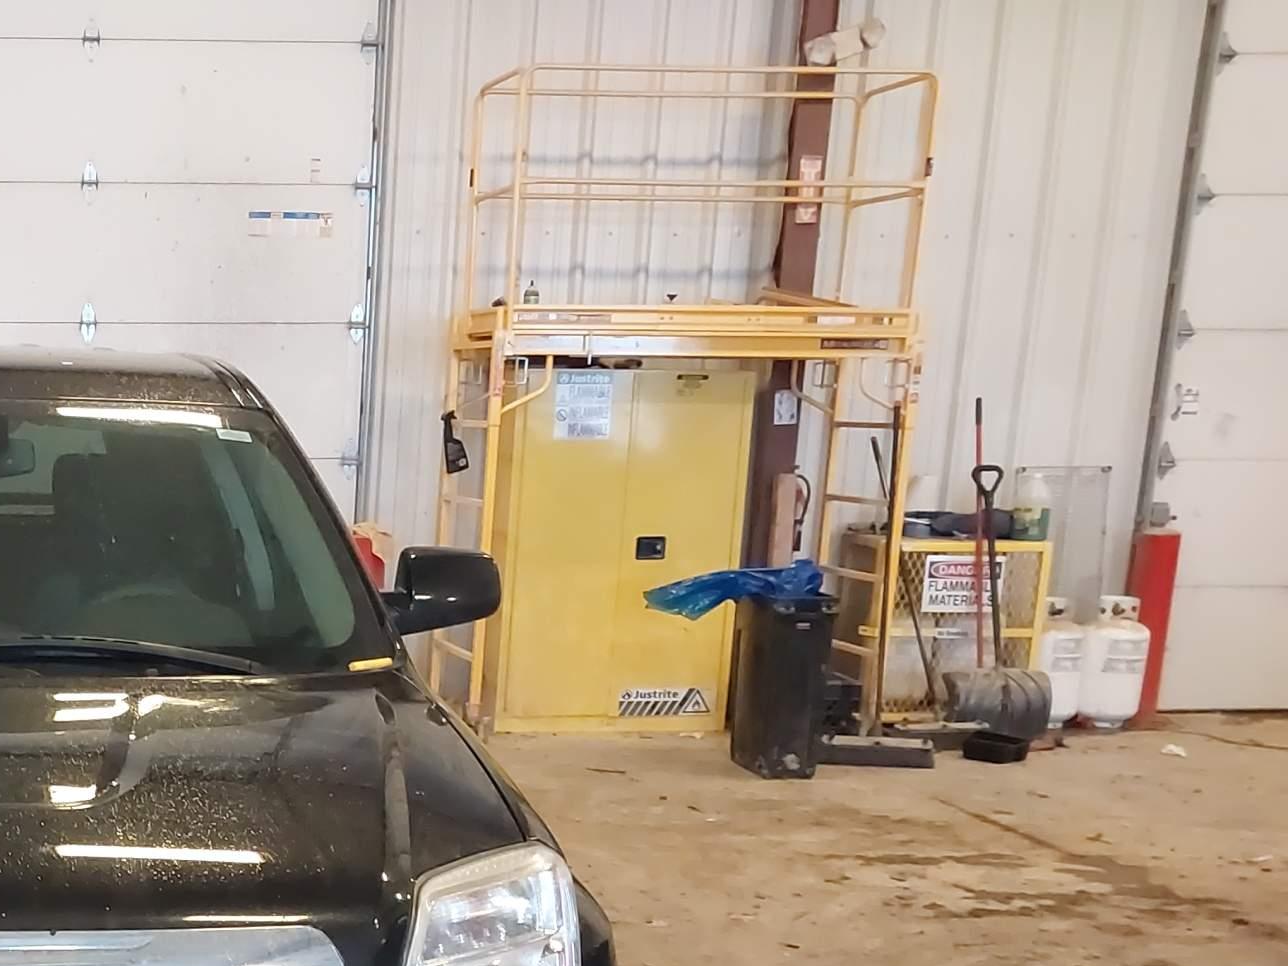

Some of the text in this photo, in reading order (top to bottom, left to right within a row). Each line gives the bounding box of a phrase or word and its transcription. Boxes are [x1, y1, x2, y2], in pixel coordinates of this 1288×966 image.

[939, 564, 991, 575] DANGR
[928, 580, 992, 593] FLAMMAL
[634, 690, 680, 700] Justrite
